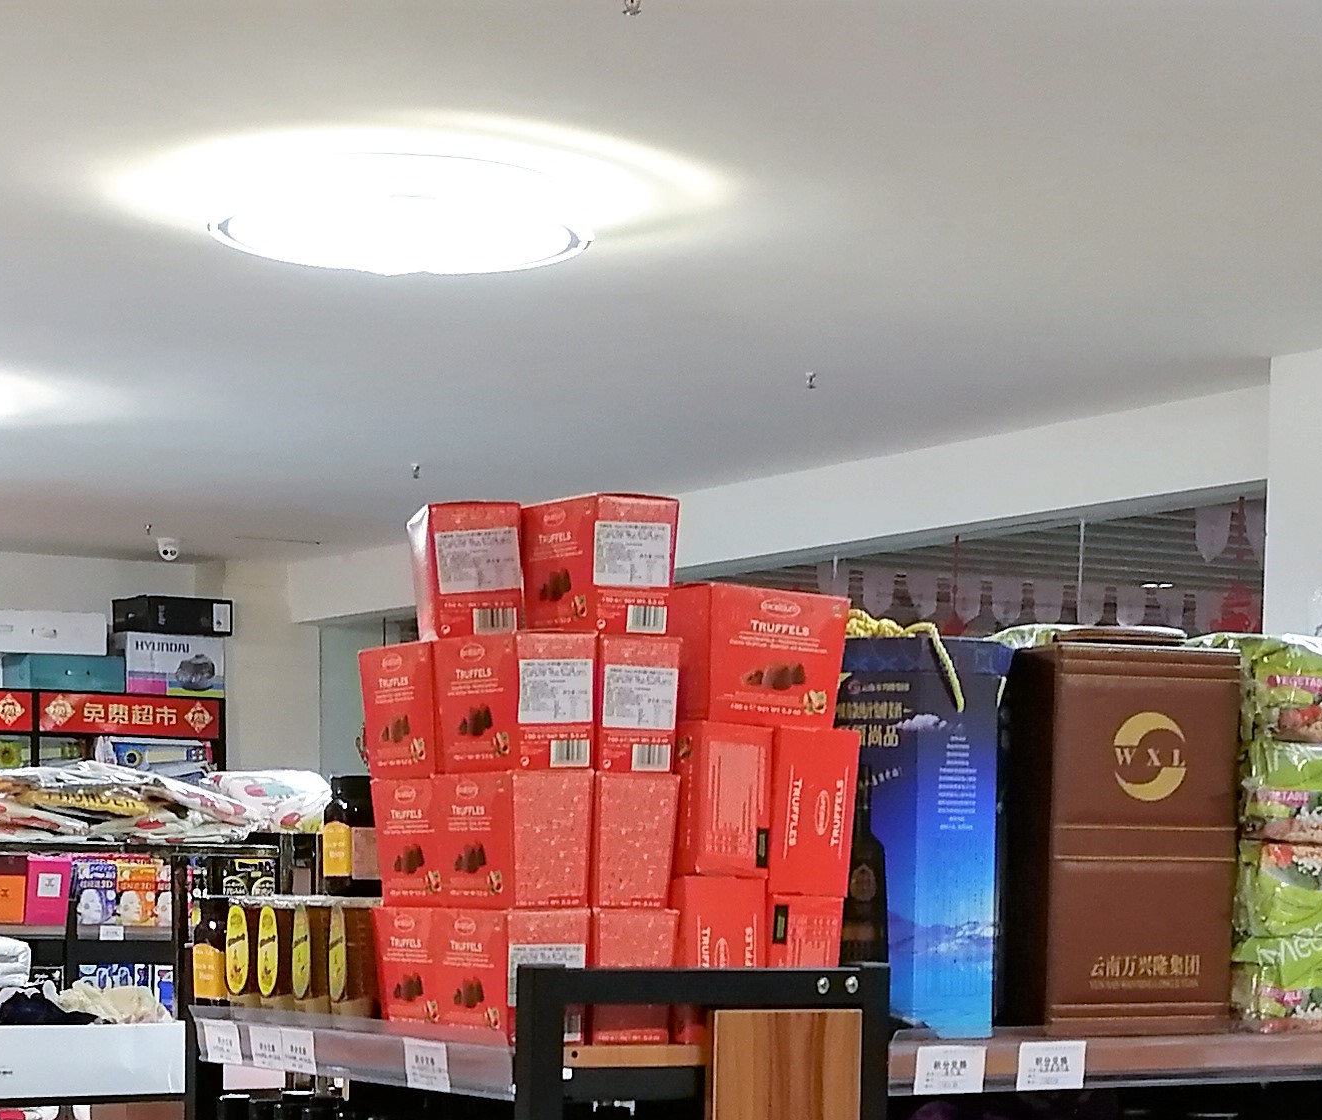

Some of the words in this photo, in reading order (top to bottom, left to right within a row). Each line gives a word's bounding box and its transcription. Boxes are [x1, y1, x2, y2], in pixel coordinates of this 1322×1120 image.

[750, 620, 810, 636] TRUFFELS
[135, 640, 190, 653] HYUNDAI
[83, 702, 177, 726] 免费超市
[1089, 954, 1201, 979] 云南万兴隆集团
